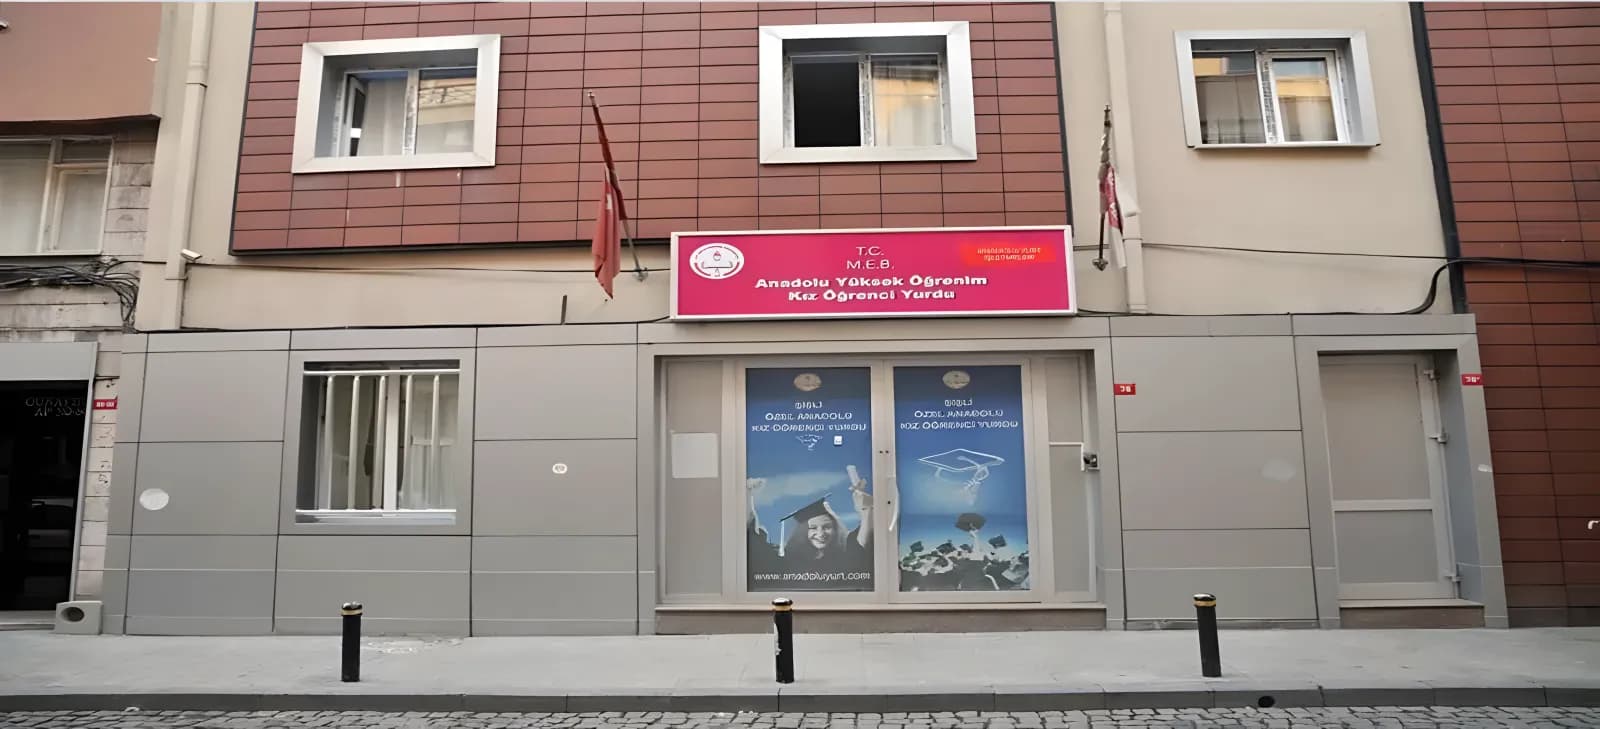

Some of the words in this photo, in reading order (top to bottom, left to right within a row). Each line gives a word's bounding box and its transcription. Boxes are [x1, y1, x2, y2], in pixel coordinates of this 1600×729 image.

[855, 246, 885, 256] T.C.
[846, 260, 895, 269] M.E.B.
[755, 277, 830, 288] Anadolu
[835, 275, 904, 287] Yüksek
[909, 274, 988, 287] Öğrenim
[901, 290, 956, 300] Yurdu
